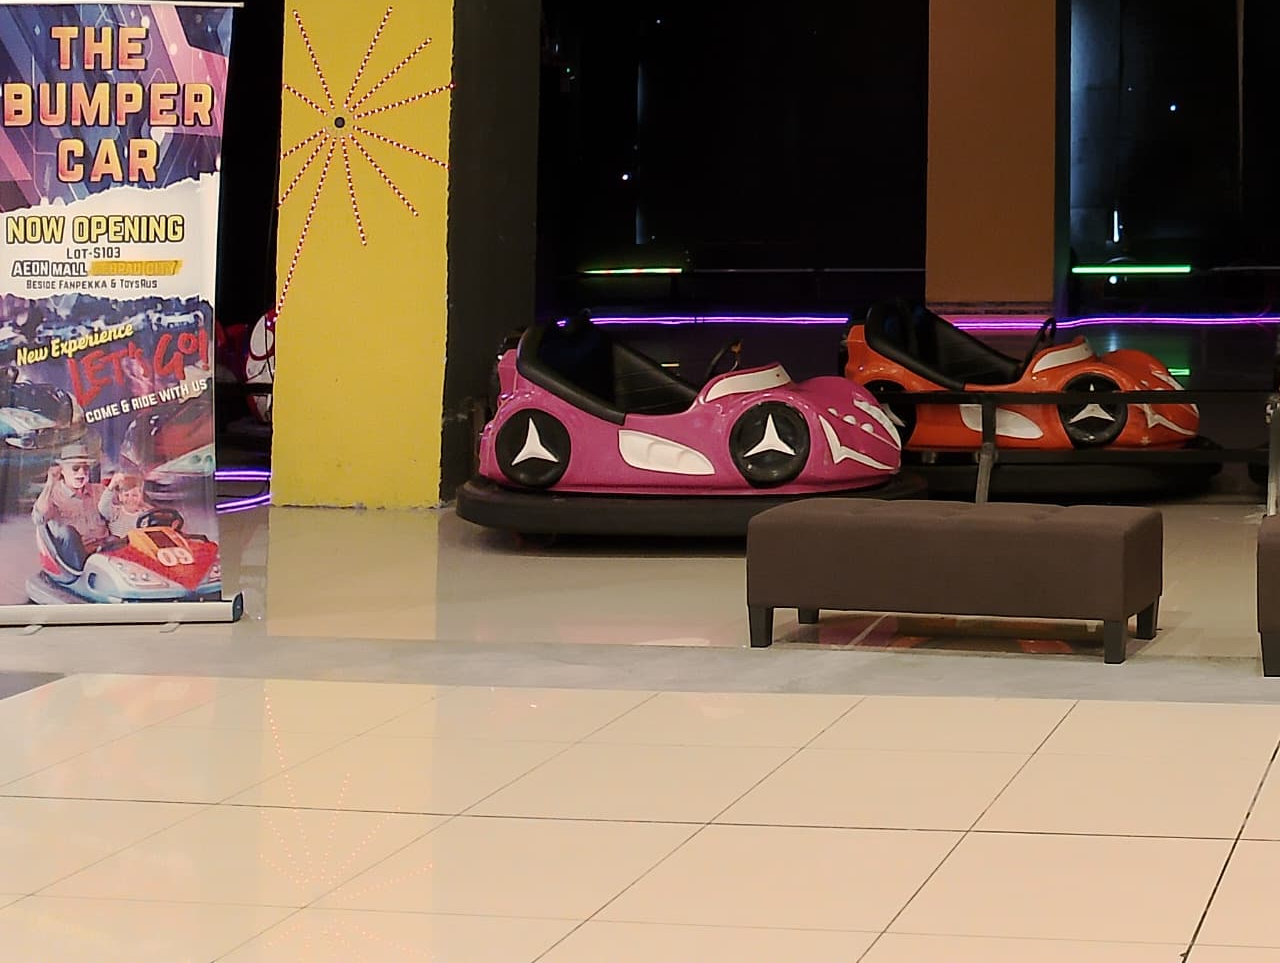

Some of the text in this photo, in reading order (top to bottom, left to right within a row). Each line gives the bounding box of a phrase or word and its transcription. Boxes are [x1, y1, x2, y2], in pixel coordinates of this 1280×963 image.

[51, 26, 150, 71] THE
[3, 82, 215, 127] BUMPER
[57, 137, 159, 183] CAR
[6, 214, 185, 244] NOW OPENING
[12, 260, 49, 277] AEON
[51, 262, 88, 277] MALL
[16, 324, 134, 366] New Experience
[85, 379, 208, 424] COME & RIDE WITH US
